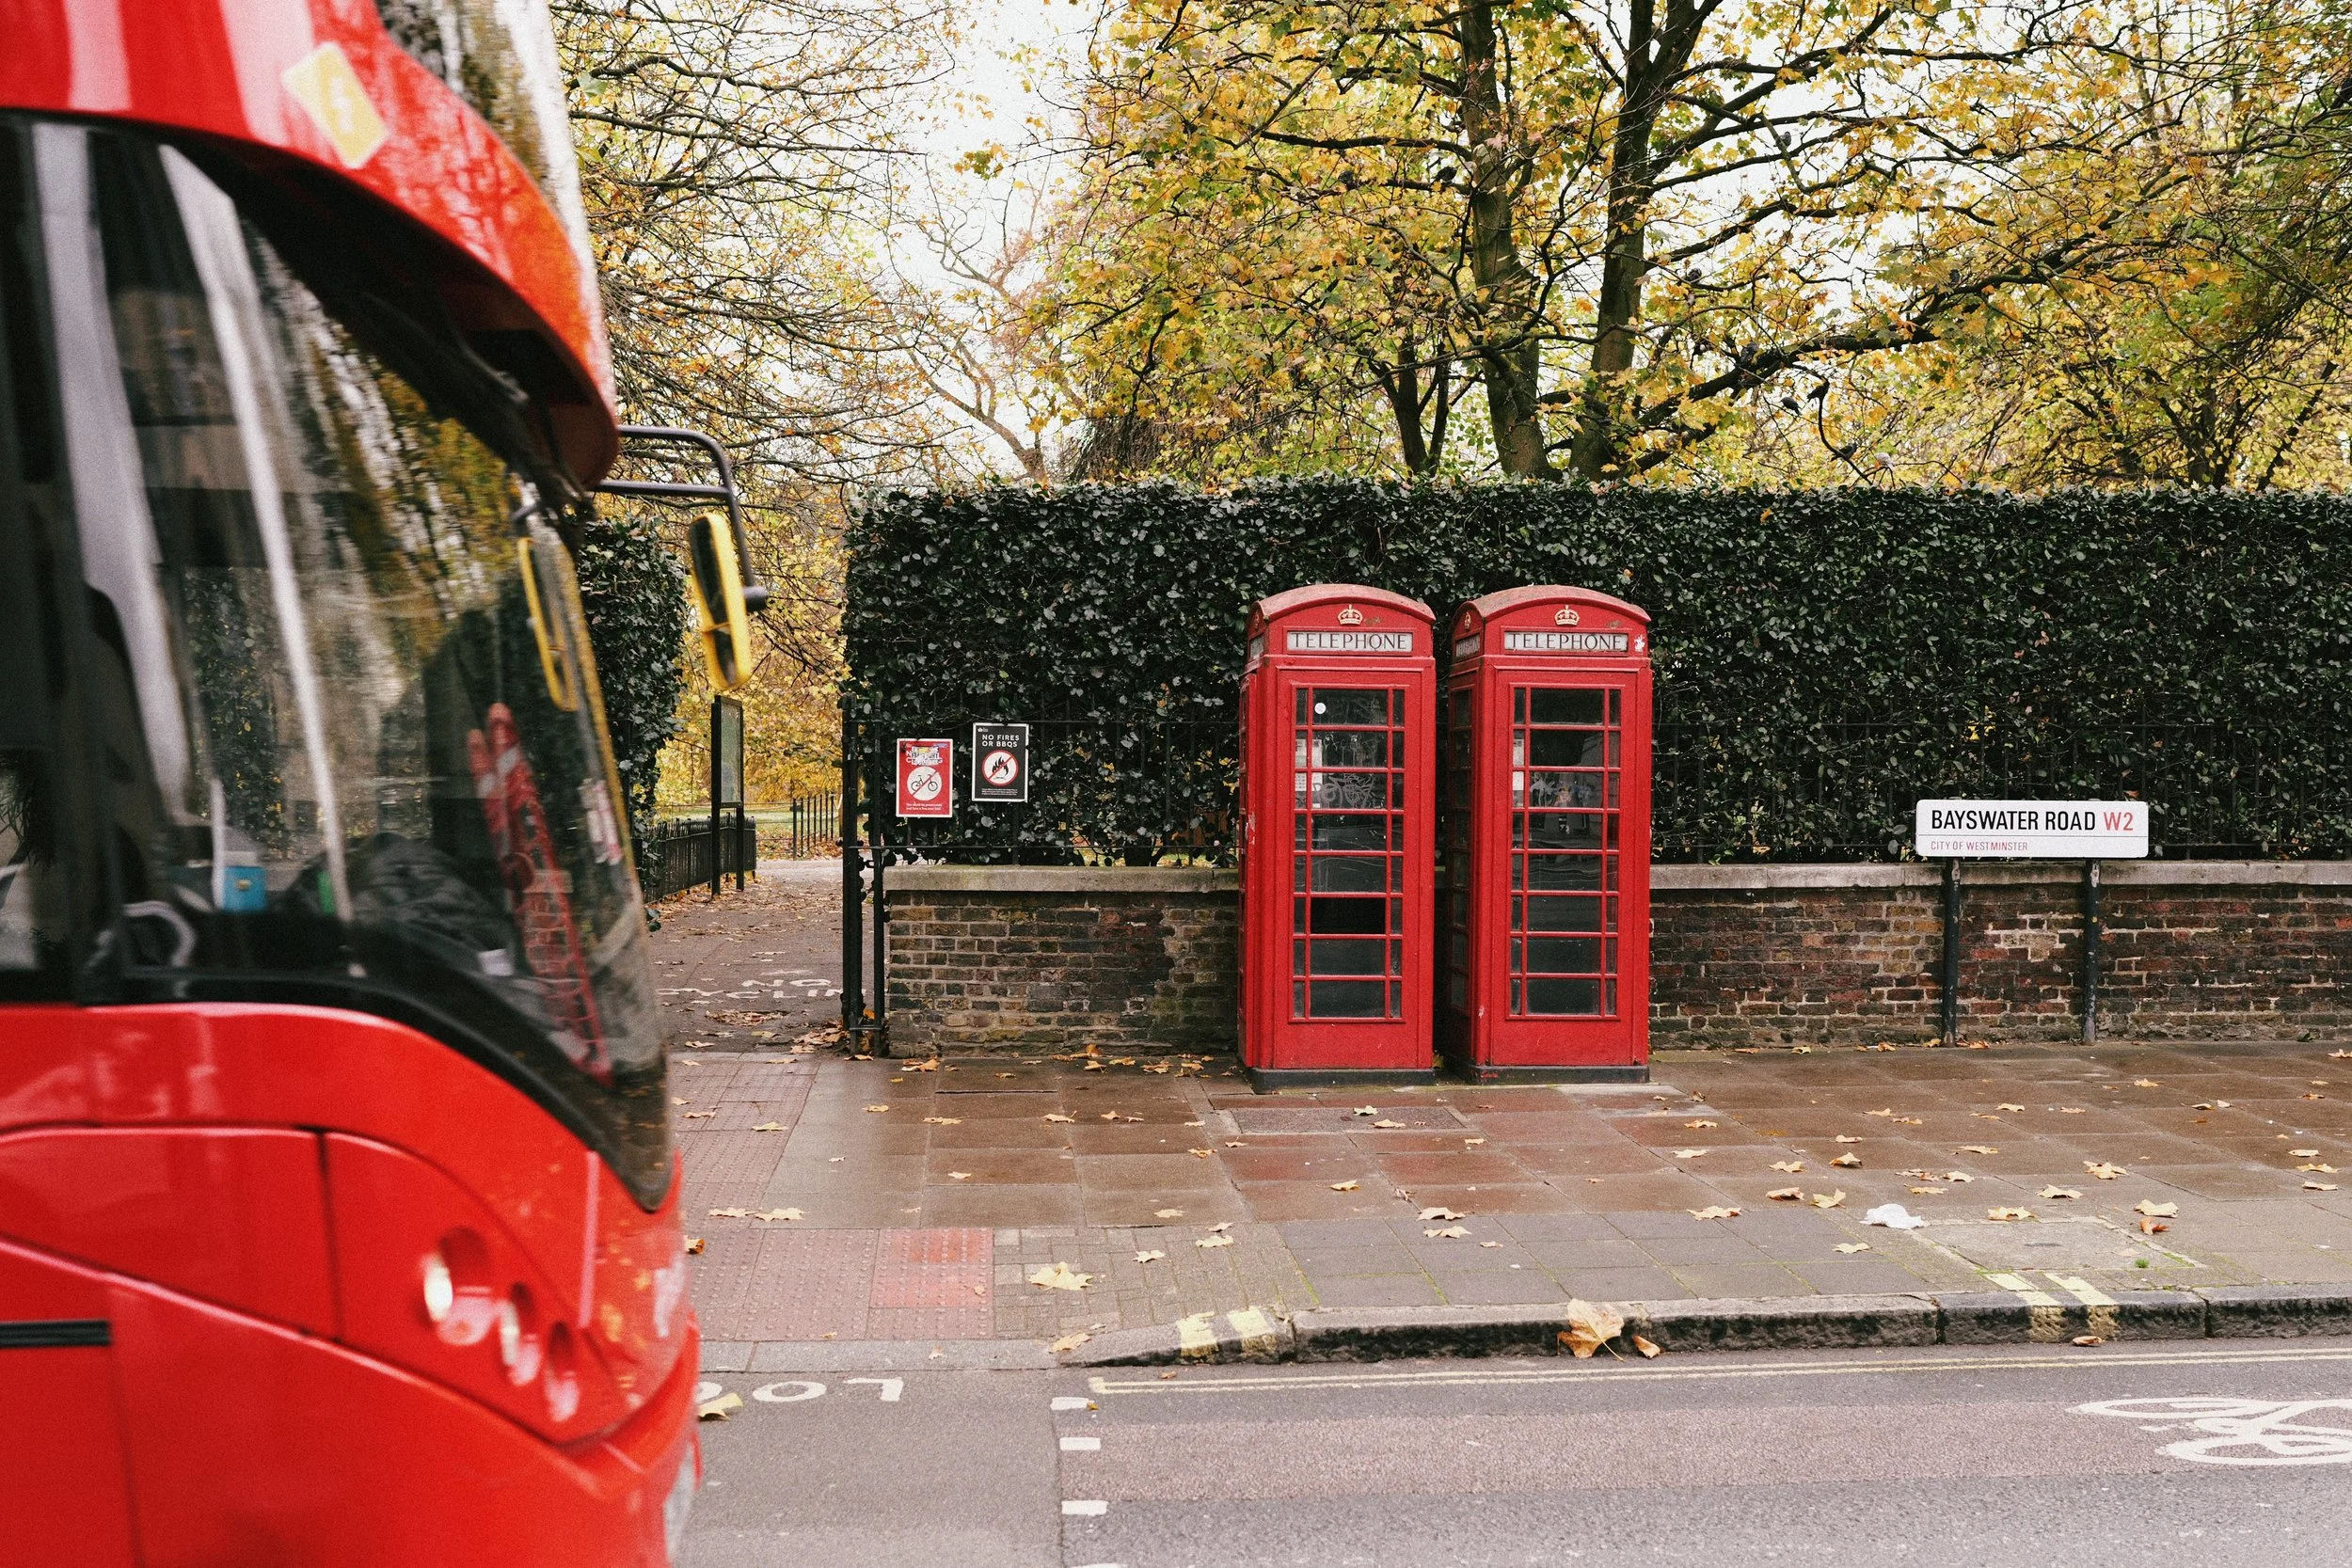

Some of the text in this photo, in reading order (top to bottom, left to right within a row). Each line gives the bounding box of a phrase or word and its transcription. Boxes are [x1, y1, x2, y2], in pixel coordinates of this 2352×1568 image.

[1291, 632, 1407, 650] TELEPHONE
[1508, 633, 1623, 650] TELEPHONE
[1931, 810, 2134, 832] BAYSWATER ROAD W2
[1931, 841, 2028, 851] CITY OF WESTMINSTER
[741, 979, 832, 988] NO
